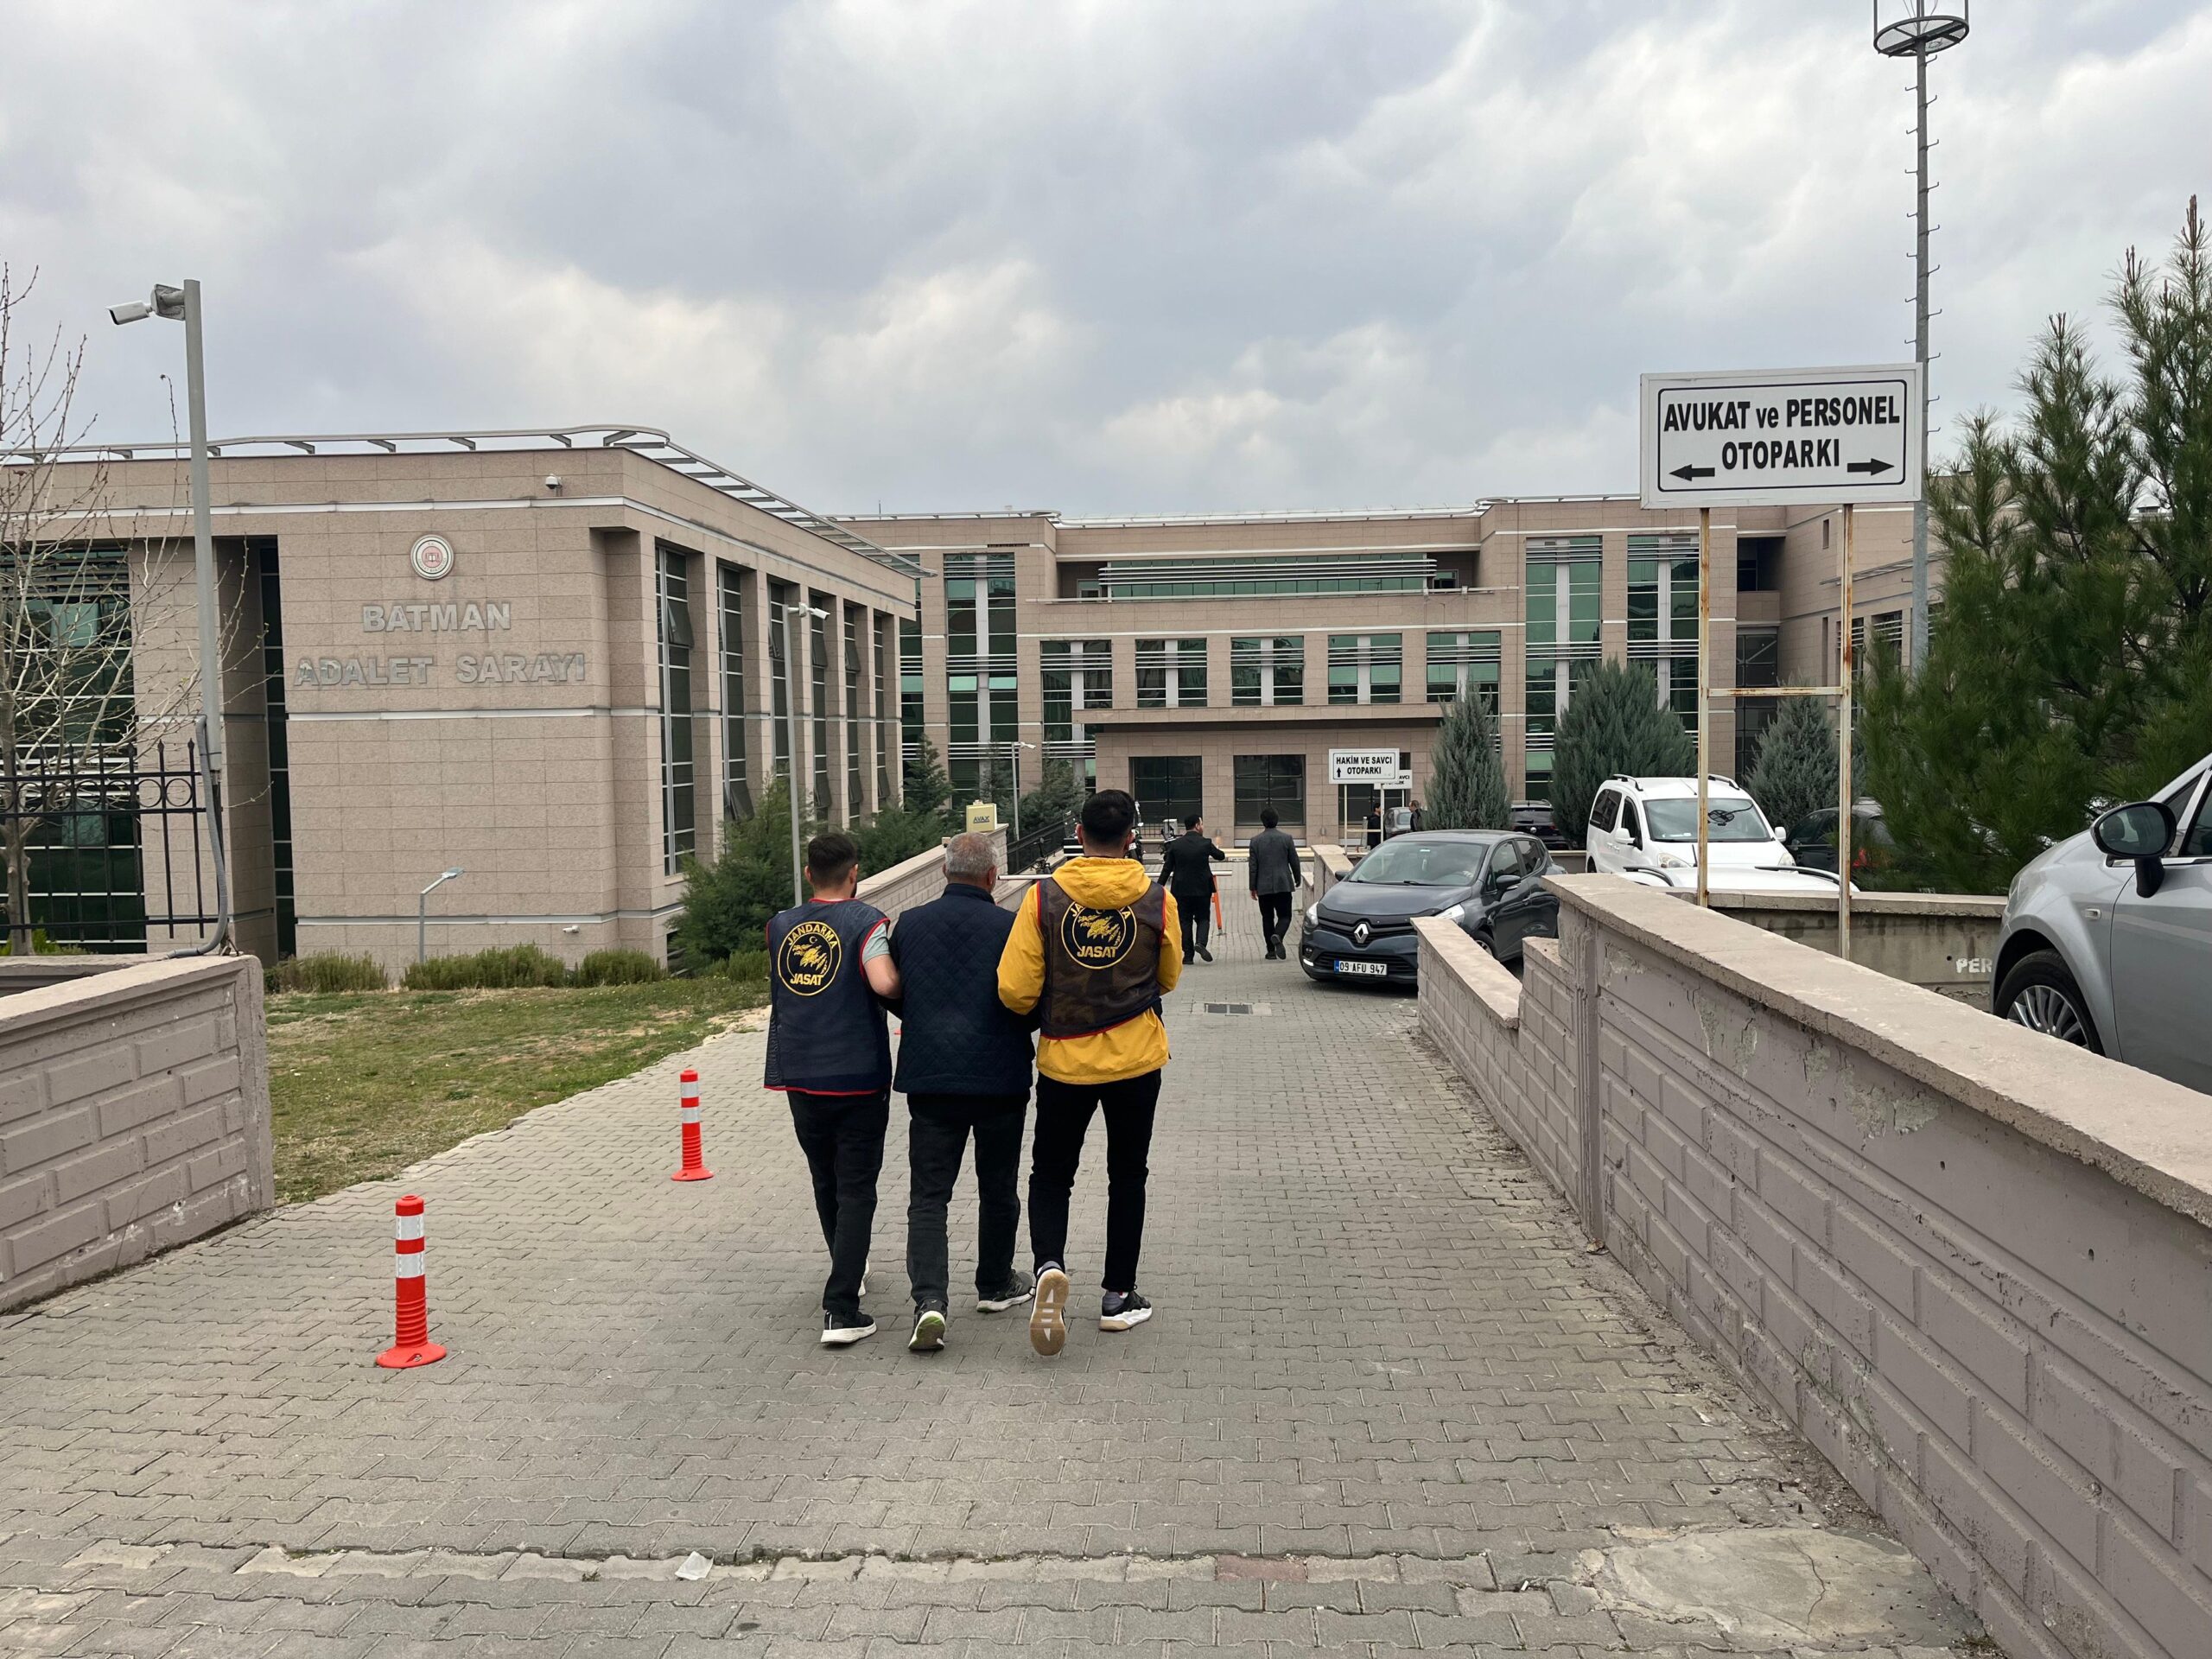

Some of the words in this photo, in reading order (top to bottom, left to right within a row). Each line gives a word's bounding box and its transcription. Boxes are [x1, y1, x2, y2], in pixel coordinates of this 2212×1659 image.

[1663, 401, 1751, 431] AVUKAT
[1756, 405, 1779, 429] ve
[1786, 396, 1900, 427] PERSONEL
[1722, 438, 1840, 469] OTOPARKI
[362, 603, 512, 632] BATMAN
[294, 656, 432, 685] ADALET
[455, 653, 586, 683] SARAYI
[1336, 755, 1358, 765] HAKİM
[787, 924, 838, 949] JANDARMA
[1077, 946, 1117, 957] JASAT
[1340, 963, 1349, 971] 09
[1352, 963, 1367, 972] AFU
[1370, 964, 1384, 974] 947
[1956, 958, 1992, 973] PER
[790, 973, 824, 985] JASAT
